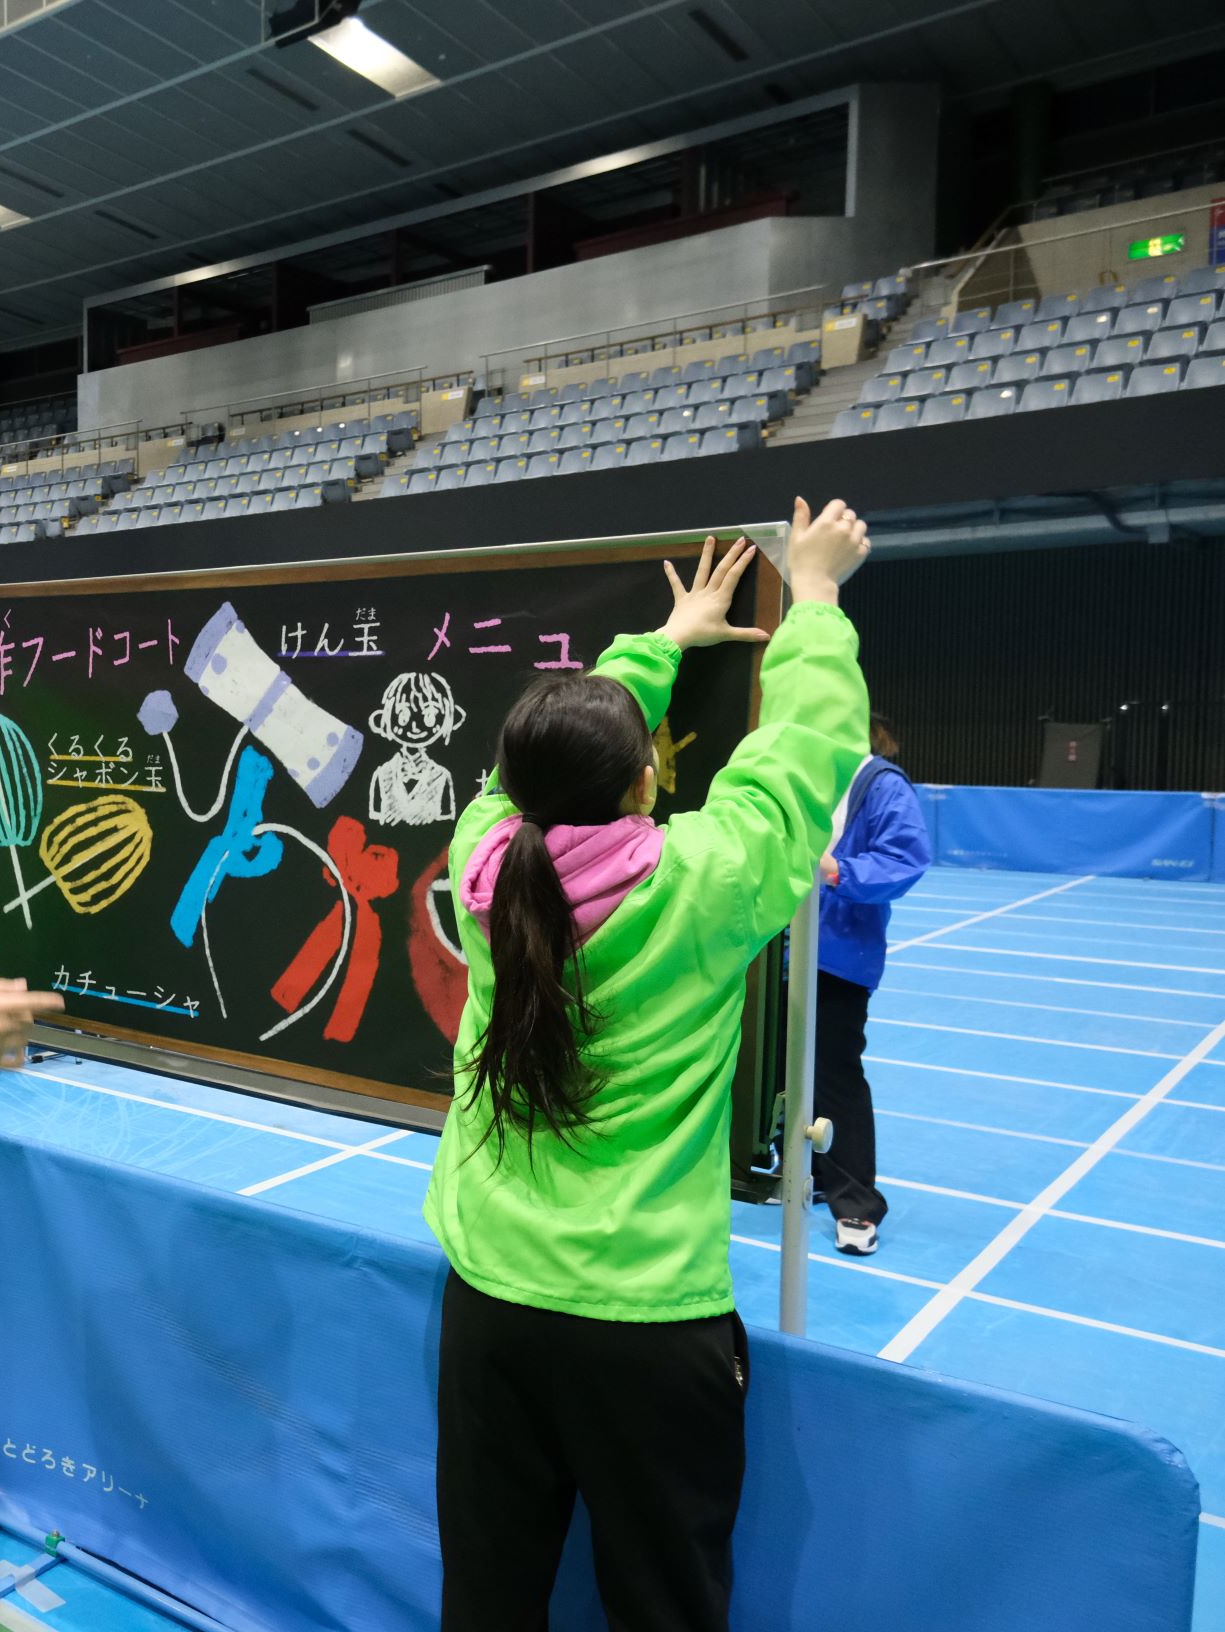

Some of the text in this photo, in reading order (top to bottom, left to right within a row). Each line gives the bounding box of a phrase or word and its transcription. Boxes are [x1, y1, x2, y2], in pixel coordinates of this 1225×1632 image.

[355, 607, 377, 621] だま
[280, 622, 383, 659] けん玉
[47, 732, 134, 762] くるくる
[46, 761, 167, 793] シャボン玉
[52, 964, 201, 1019] カチューシャ
